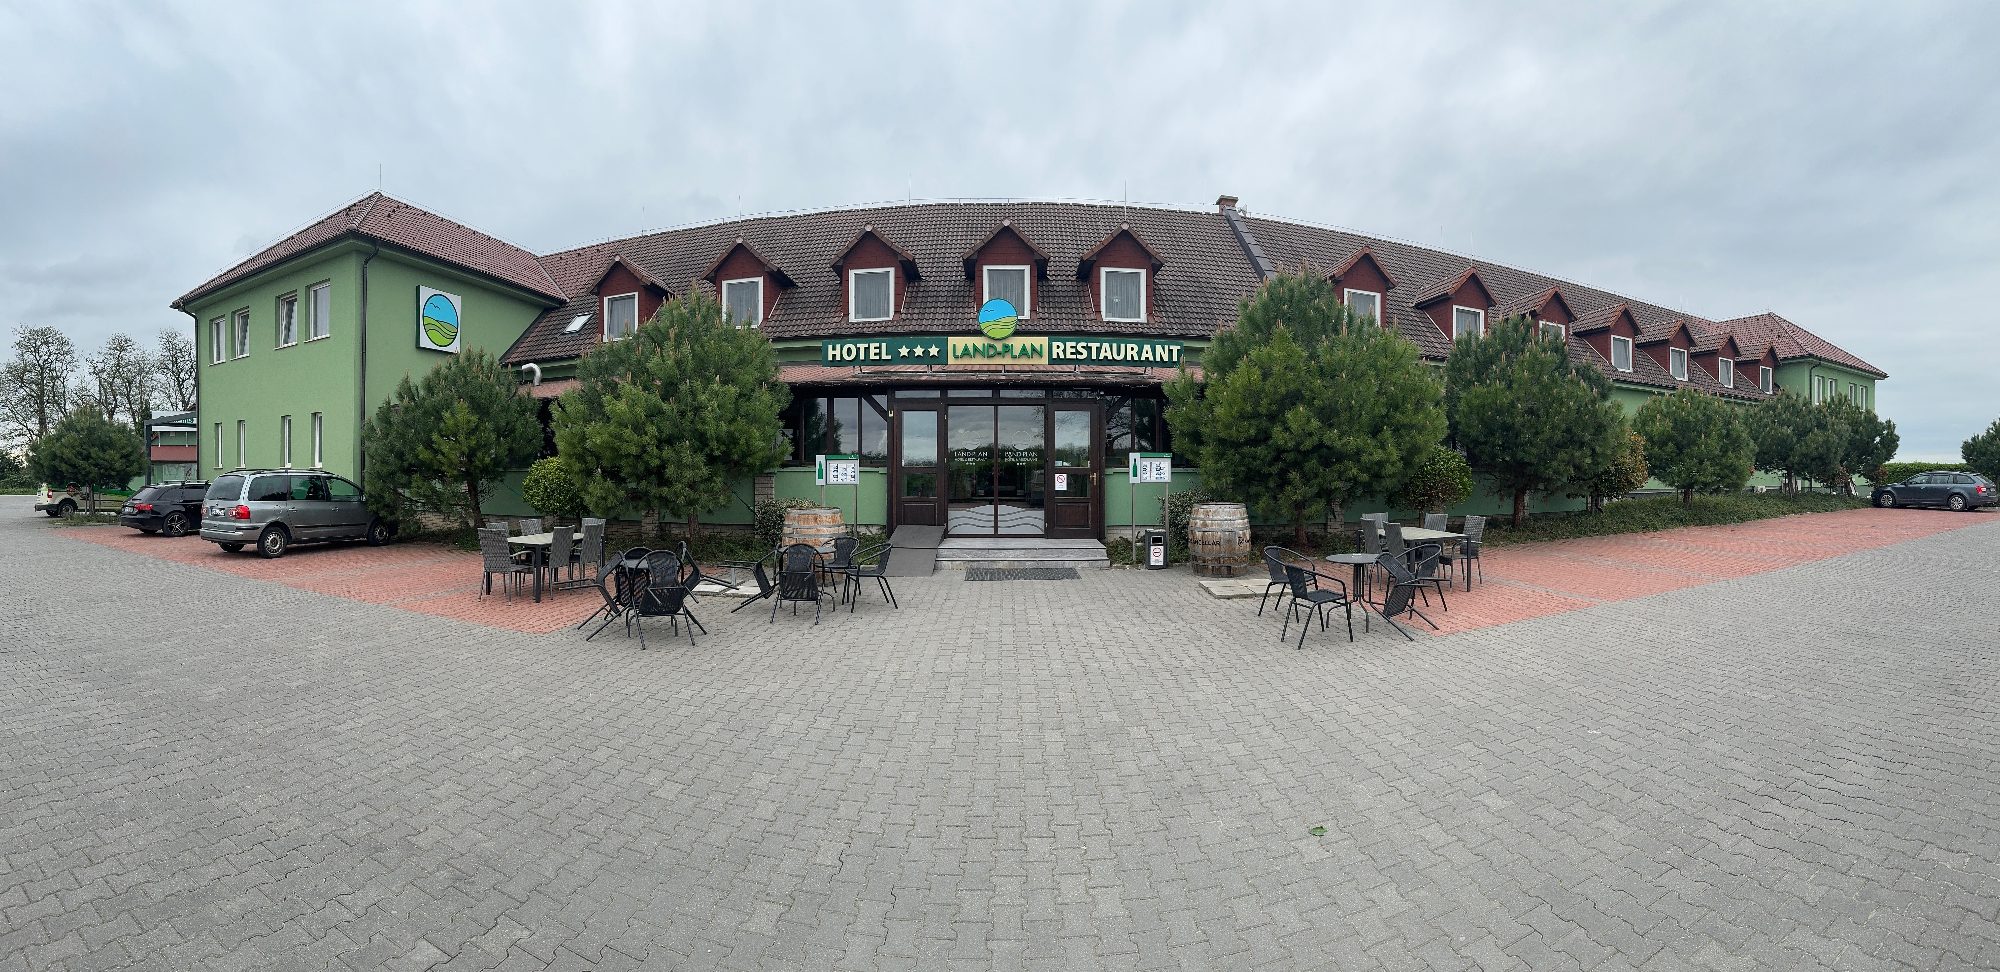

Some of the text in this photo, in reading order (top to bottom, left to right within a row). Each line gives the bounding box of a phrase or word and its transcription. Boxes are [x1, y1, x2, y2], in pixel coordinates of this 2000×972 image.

[827, 341, 1181, 362] HOTEL LAND-PLAN RESTAURANT
